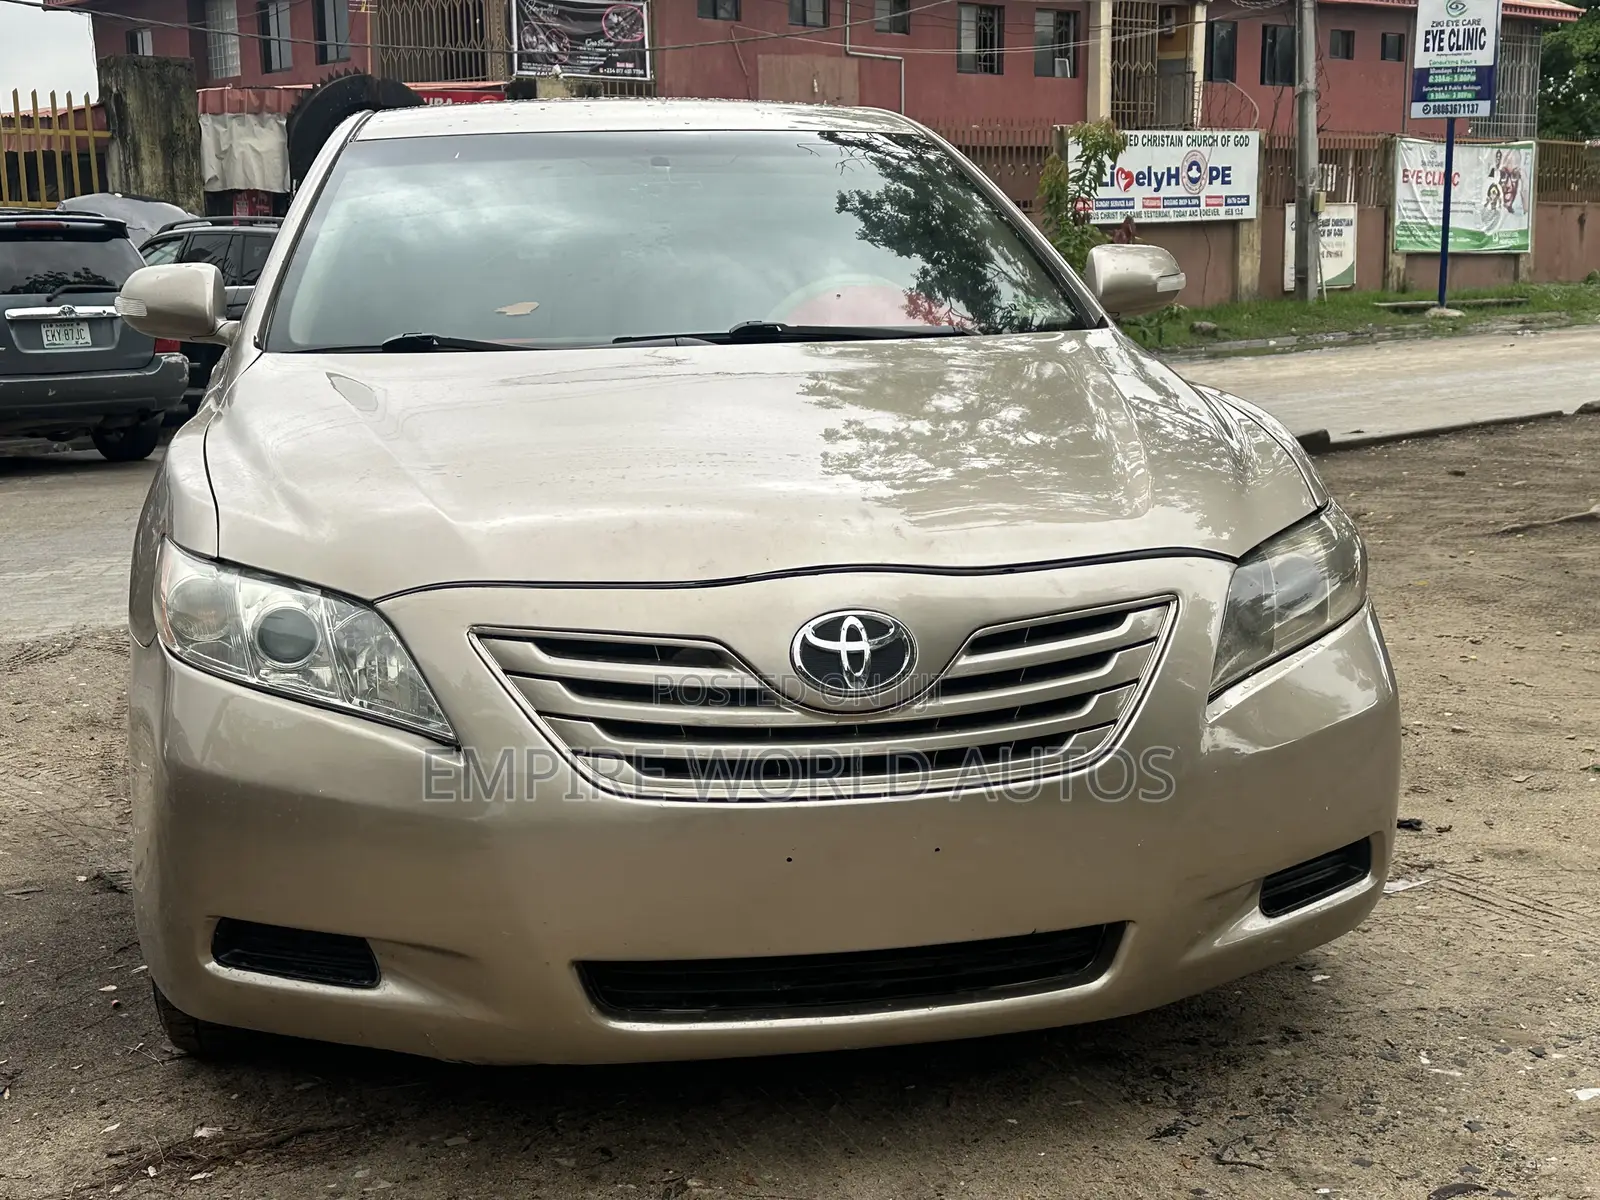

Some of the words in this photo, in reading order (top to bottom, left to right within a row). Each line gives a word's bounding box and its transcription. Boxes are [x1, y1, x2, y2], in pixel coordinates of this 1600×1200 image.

[1424, 29, 1446, 52] EYE
[1448, 27, 1487, 52] CLINIC
[1141, 134, 1183, 147] CHRISTAIN
[1186, 134, 1218, 148] CHURCH
[1221, 134, 1231, 147] OF
[1233, 134, 1250, 147] GOD
[1402, 168, 1423, 184] EYE
